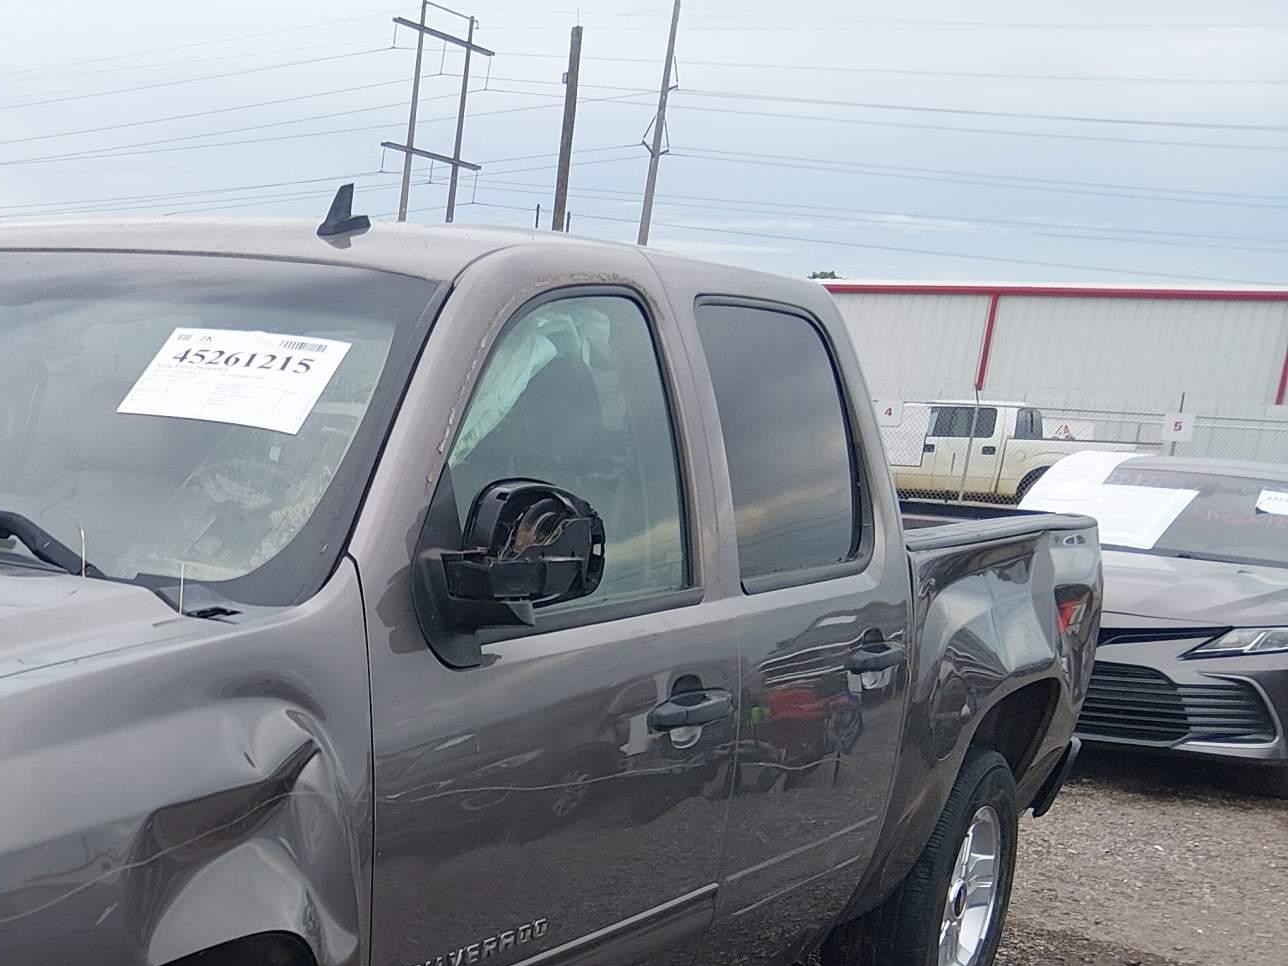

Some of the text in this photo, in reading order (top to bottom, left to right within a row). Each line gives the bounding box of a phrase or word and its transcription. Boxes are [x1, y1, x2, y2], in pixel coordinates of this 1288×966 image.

[172, 347, 315, 375] 45261215
[884, 407, 893, 417] 4
[1172, 420, 1183, 432] 5
